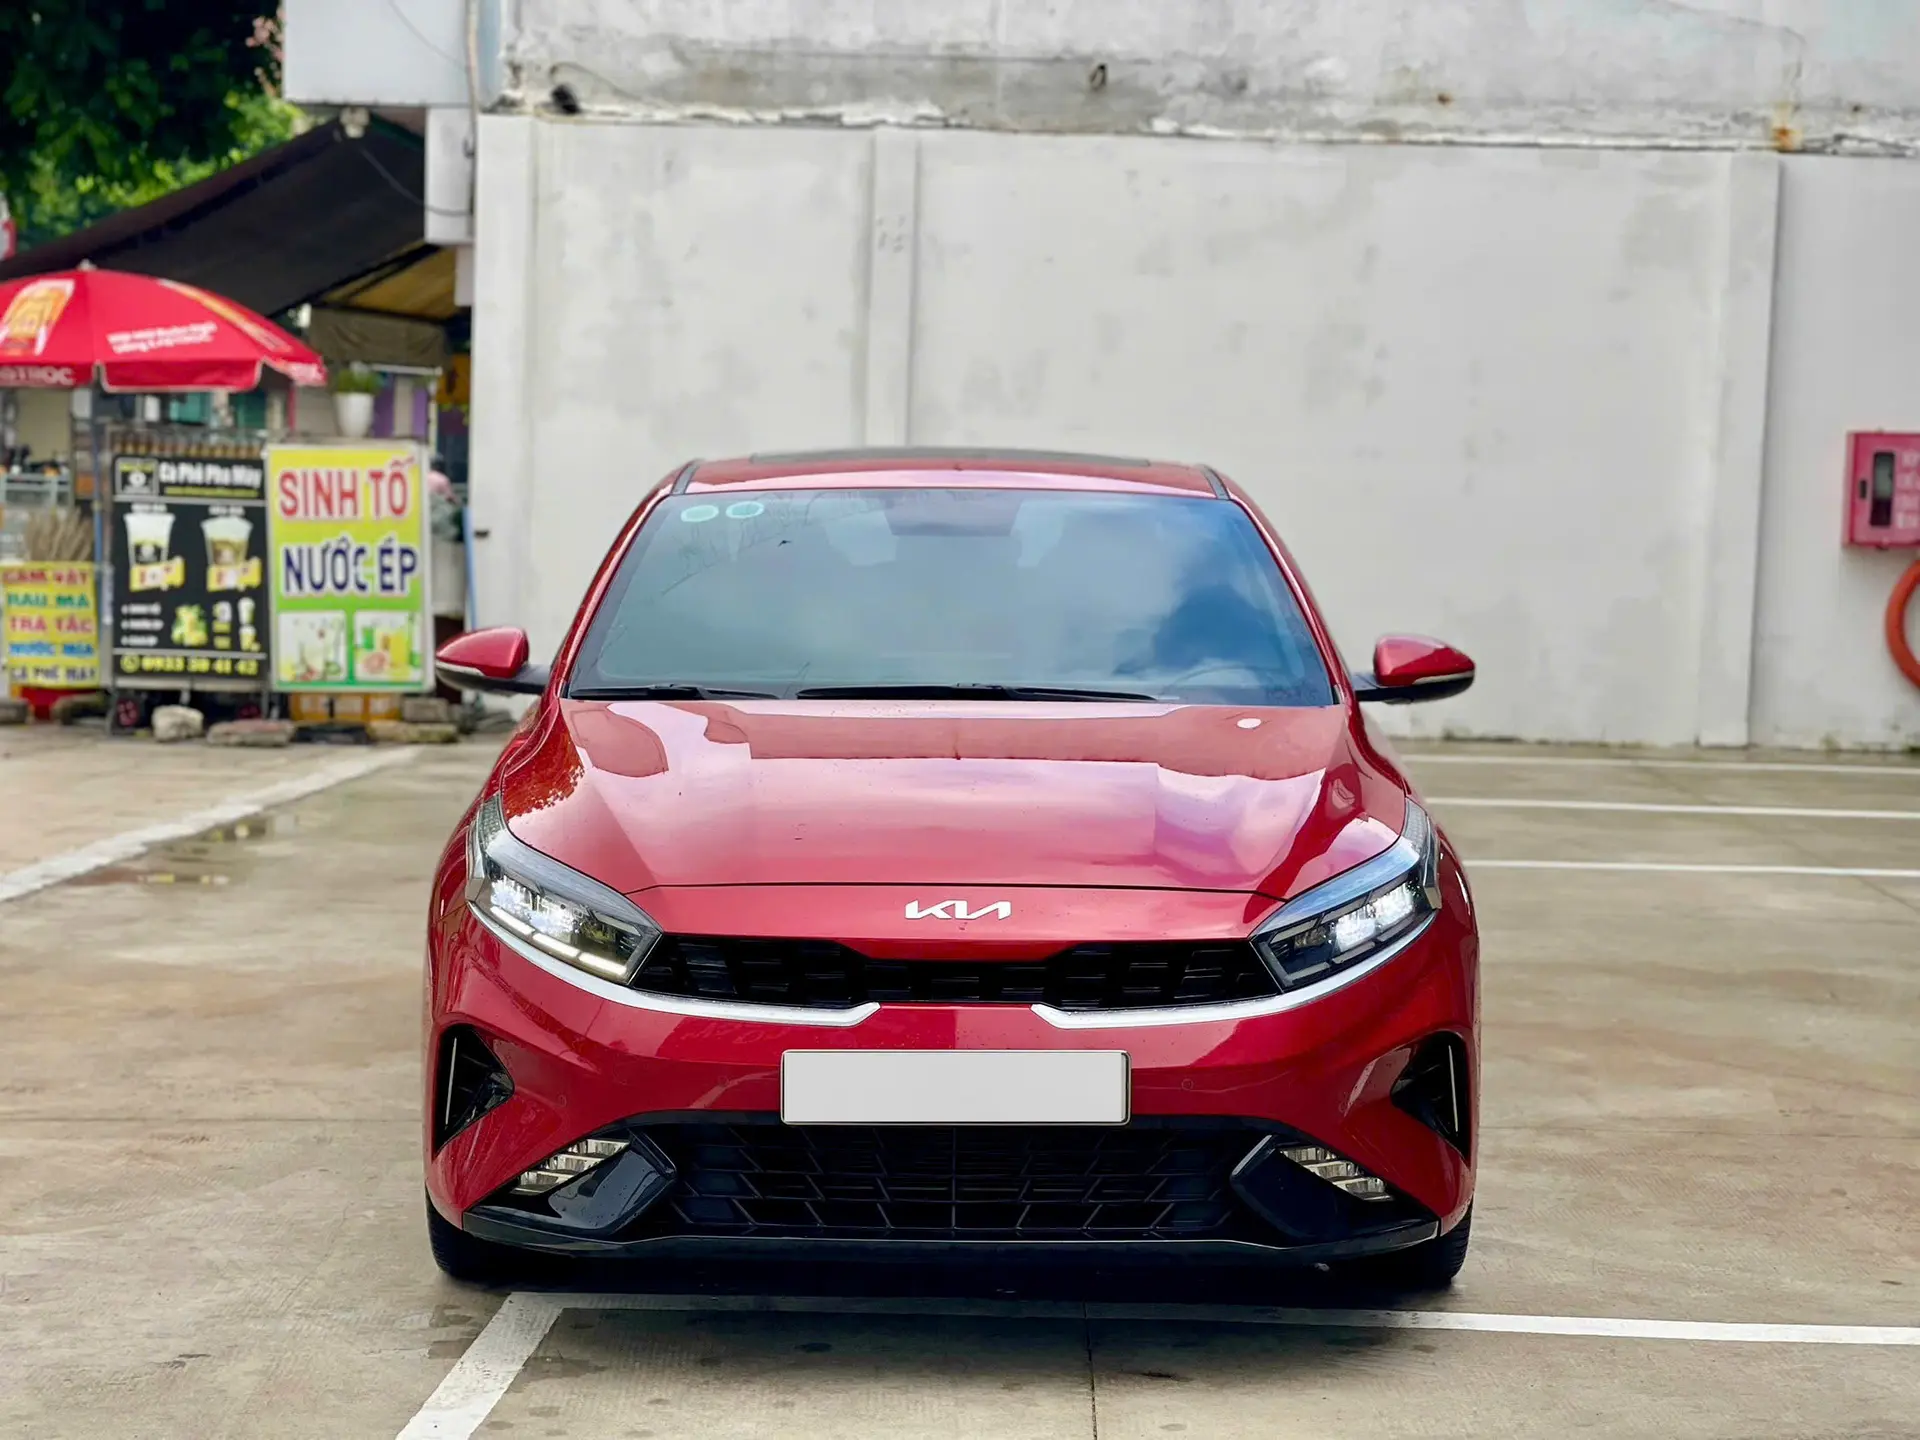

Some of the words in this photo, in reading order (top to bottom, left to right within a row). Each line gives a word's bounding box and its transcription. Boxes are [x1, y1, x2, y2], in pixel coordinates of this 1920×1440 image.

[279, 469, 359, 517] SINH
[368, 456, 415, 517] TỐ
[283, 535, 369, 592] NƯỚC
[379, 536, 417, 592] ÉP
[904, 899, 1012, 920] KIA
